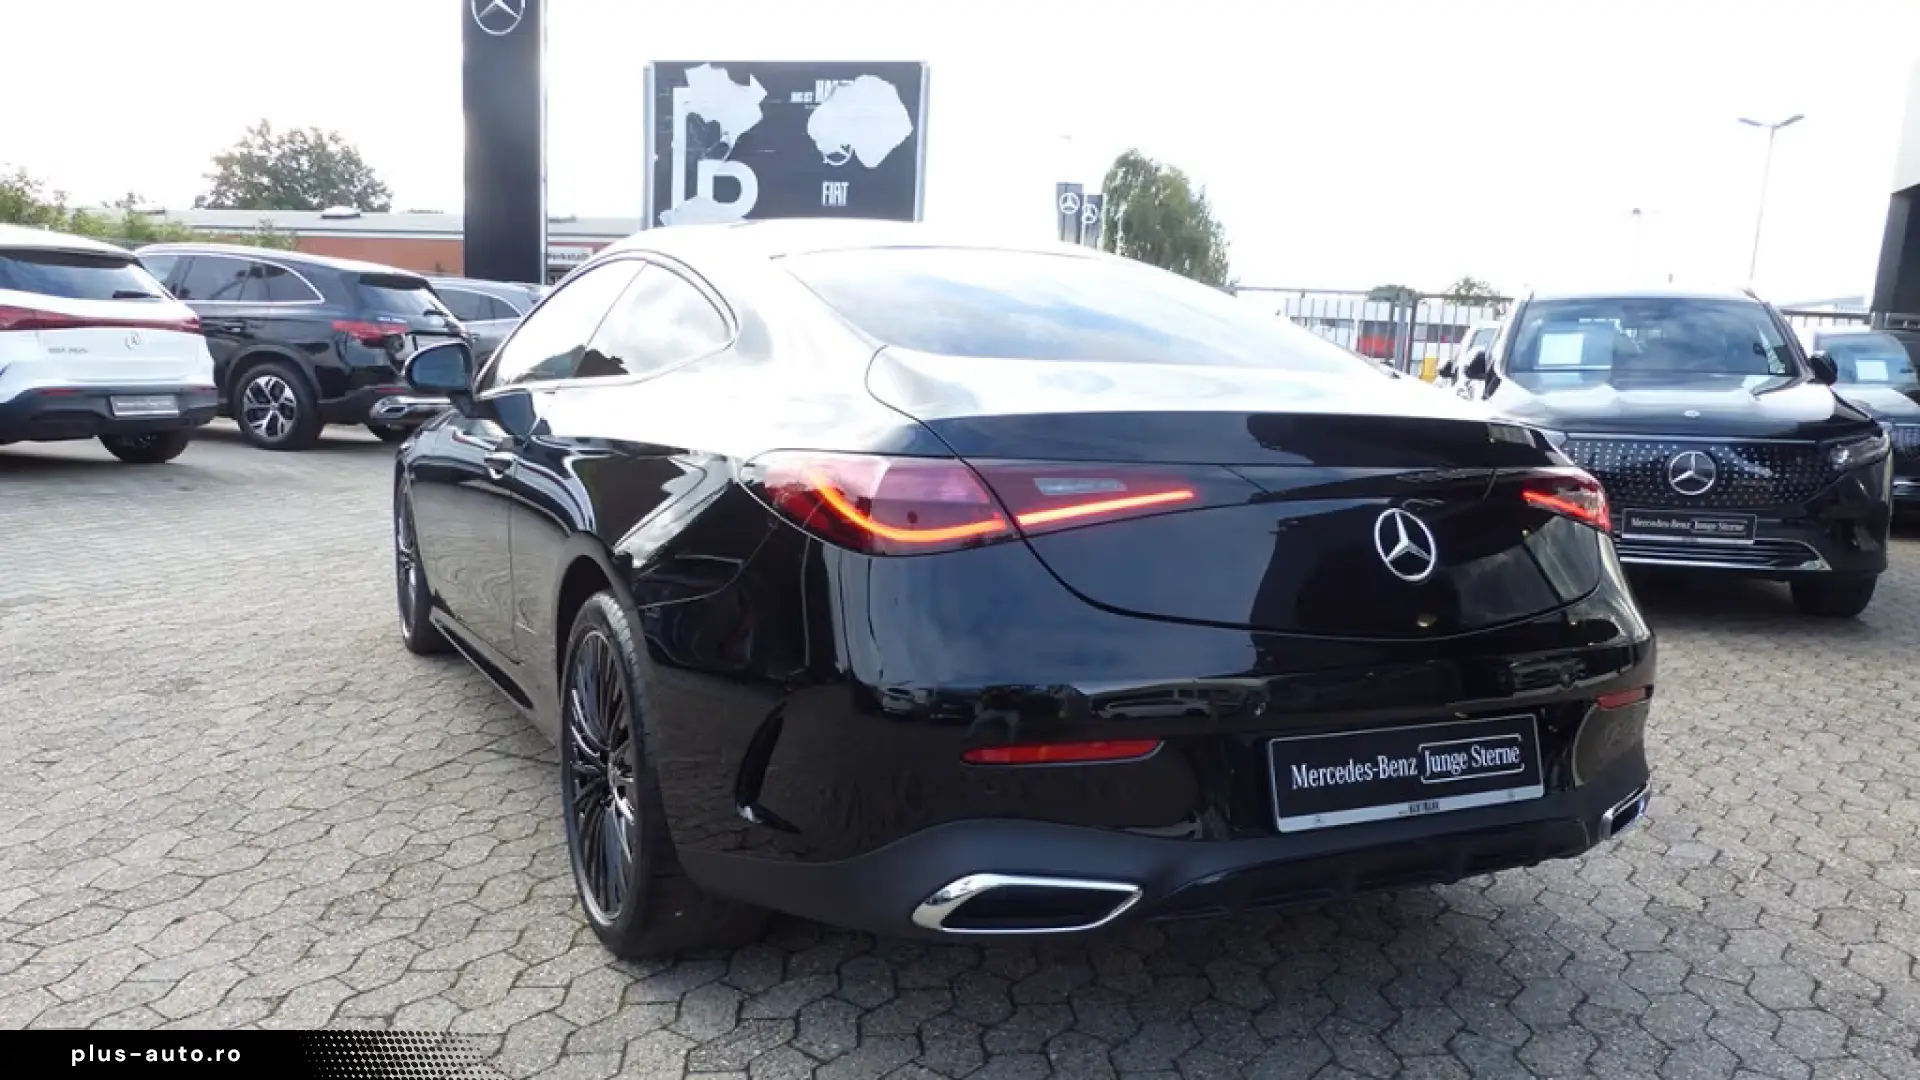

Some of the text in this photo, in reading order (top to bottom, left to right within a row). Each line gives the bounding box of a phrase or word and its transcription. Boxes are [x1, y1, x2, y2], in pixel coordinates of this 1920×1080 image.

[822, 181, 849, 206] FIAT
[1290, 744, 1520, 789] Mercedes-Benz Junge Sterne
